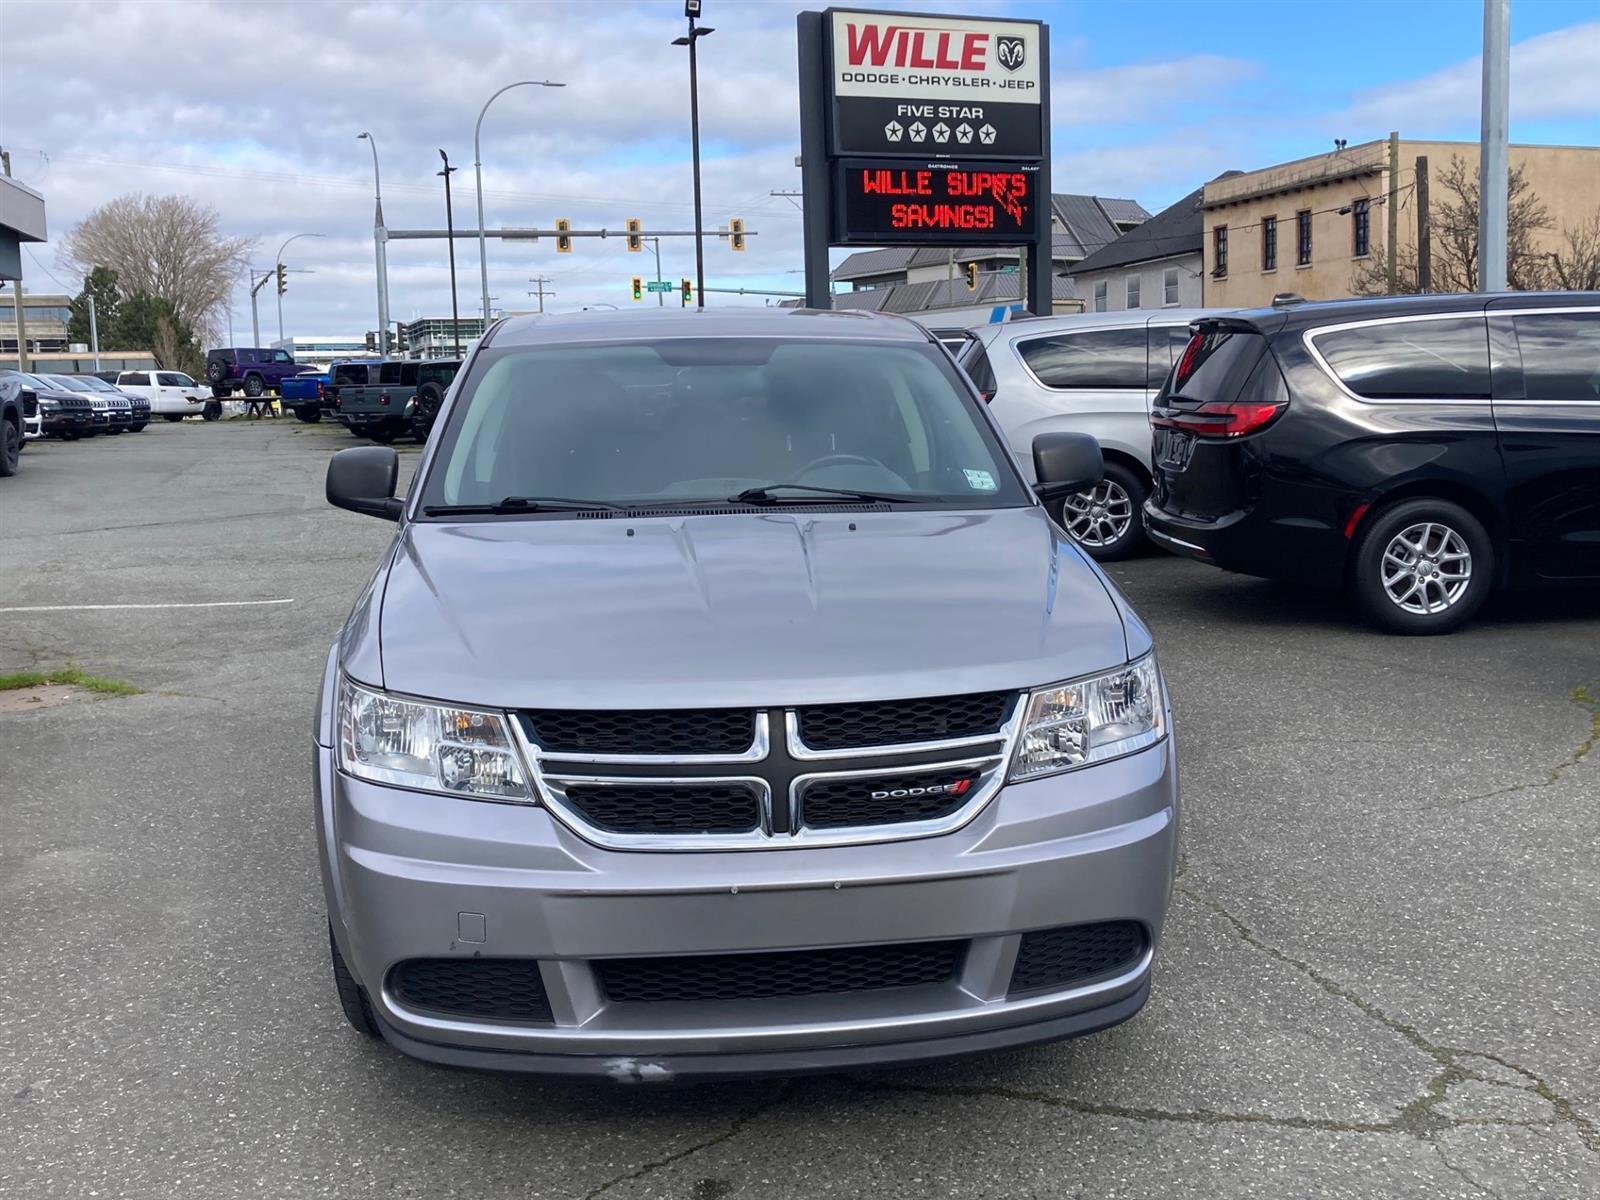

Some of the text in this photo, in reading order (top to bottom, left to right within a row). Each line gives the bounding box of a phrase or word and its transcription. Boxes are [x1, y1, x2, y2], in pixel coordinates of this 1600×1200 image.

[846, 23, 990, 71] WILLE
[842, 73, 1035, 90] DODGE CHRYSLER JEEP
[897, 105, 983, 119] FIVE STAR
[864, 170, 931, 194] WILLE
[892, 204, 994, 228] SAVINGS!
[871, 783, 959, 799] DODGE
